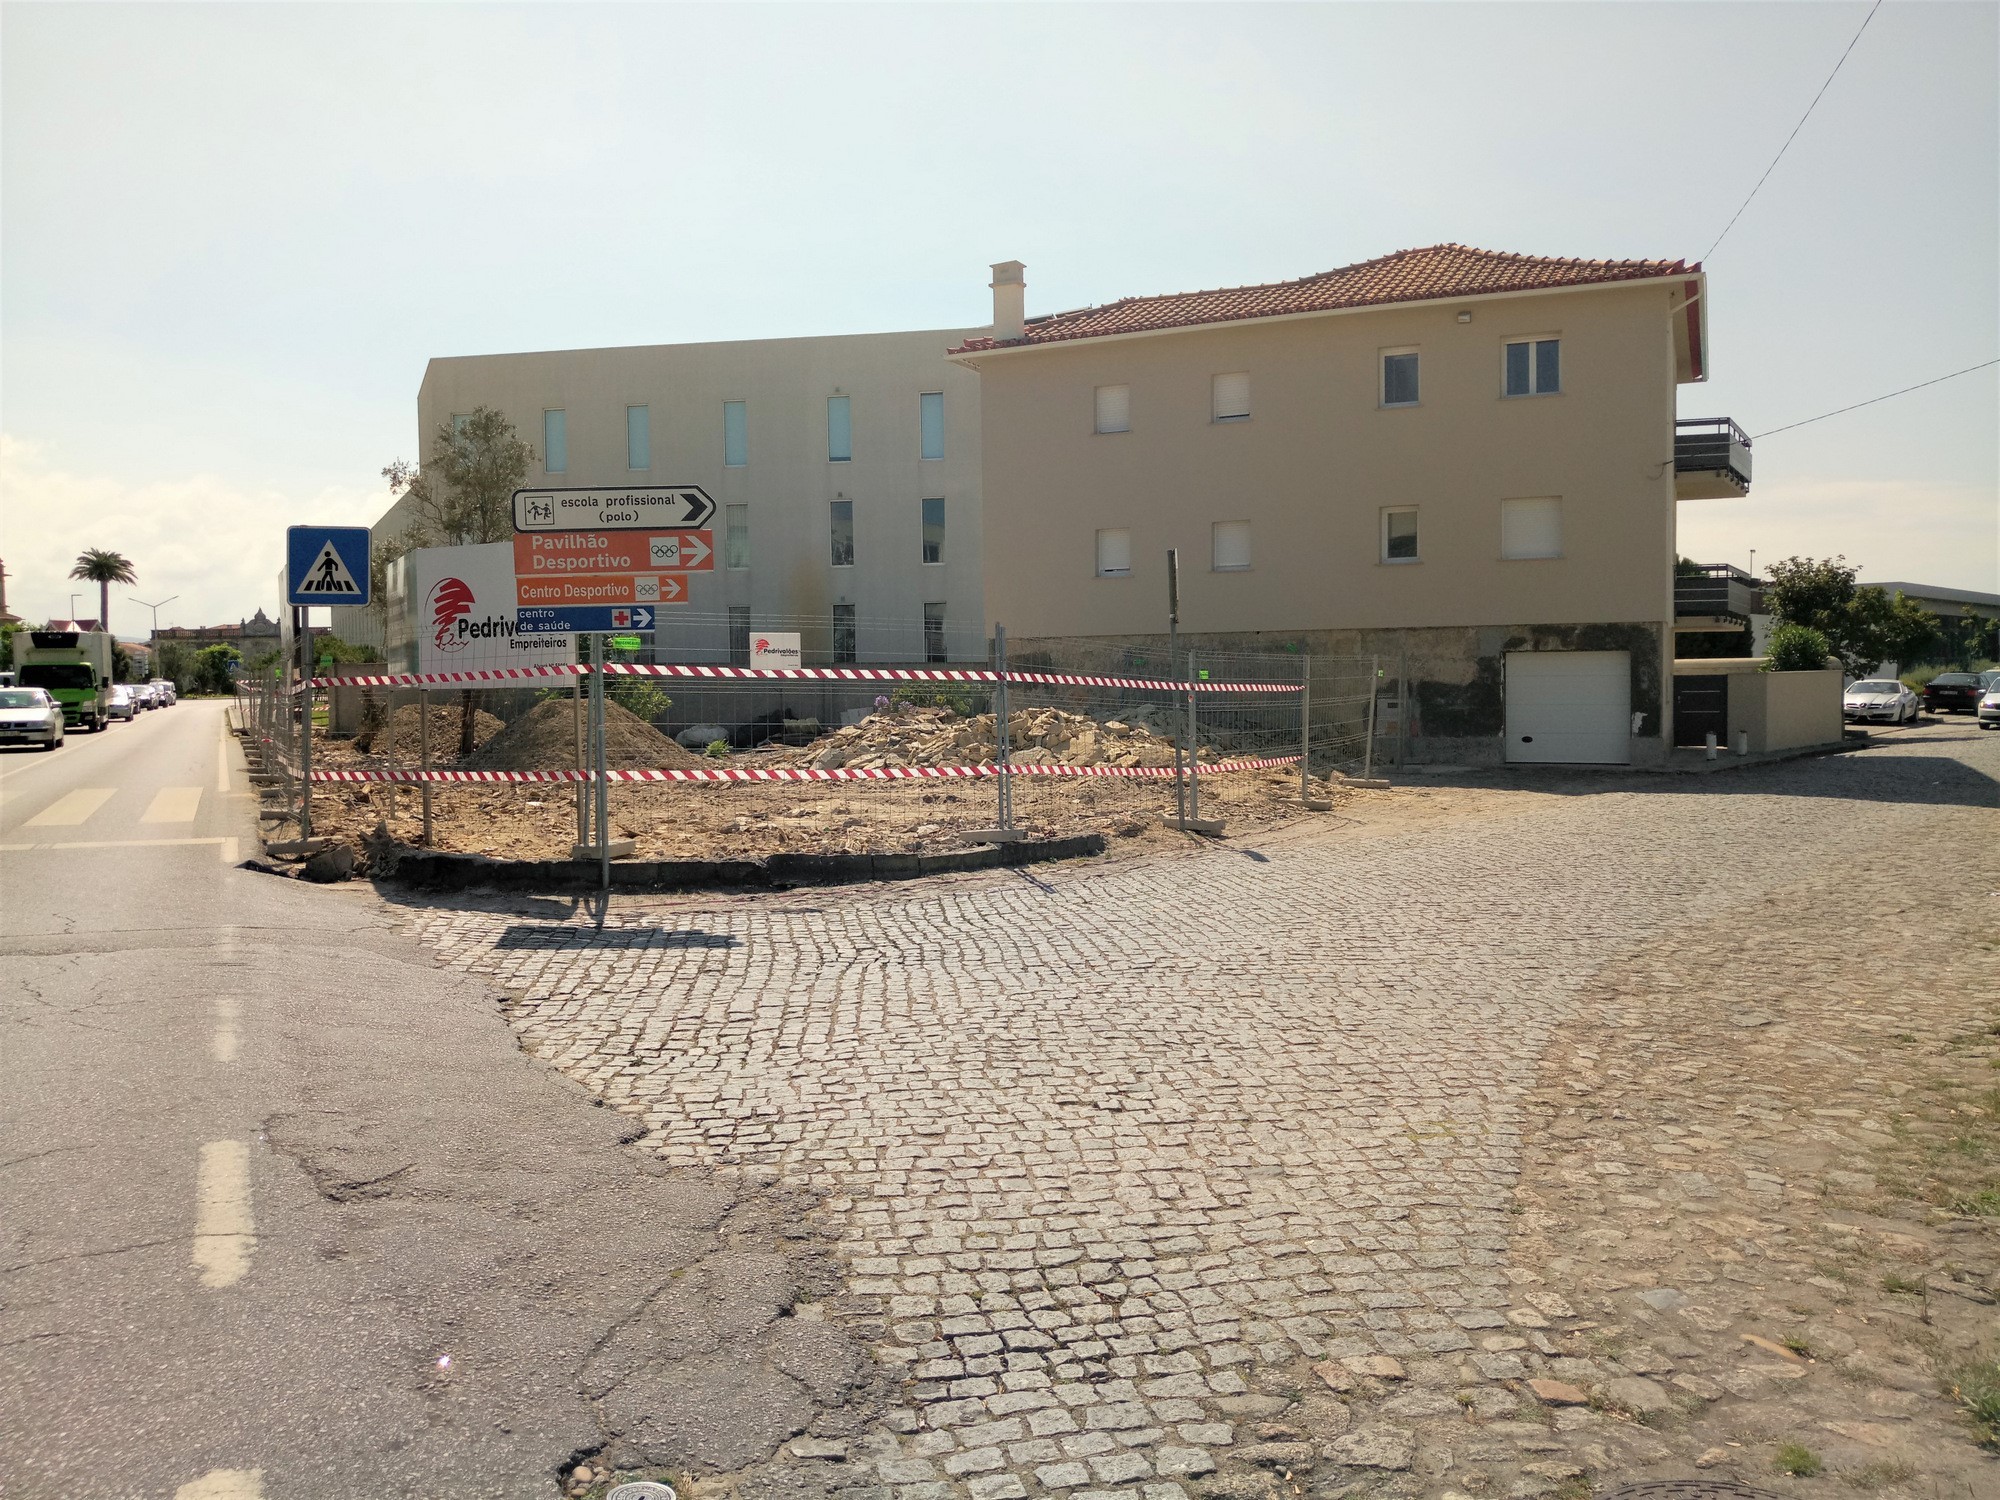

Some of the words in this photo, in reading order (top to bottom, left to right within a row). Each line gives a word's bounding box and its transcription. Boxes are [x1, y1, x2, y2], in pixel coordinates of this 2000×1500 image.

[561, 496, 598, 507] escola
[606, 494, 675, 508] profissional
[599, 510, 639, 523] (polo)
[532, 534, 608, 549] Pavilhão
[533, 554, 631, 571] Desportivo
[521, 585, 560, 598] Centro
[564, 583, 629, 599] Desportivo
[519, 609, 555, 618] centro
[520, 621, 533, 630] de
[538, 621, 571, 630] saúde
[510, 638, 567, 651] Empreiteiros
